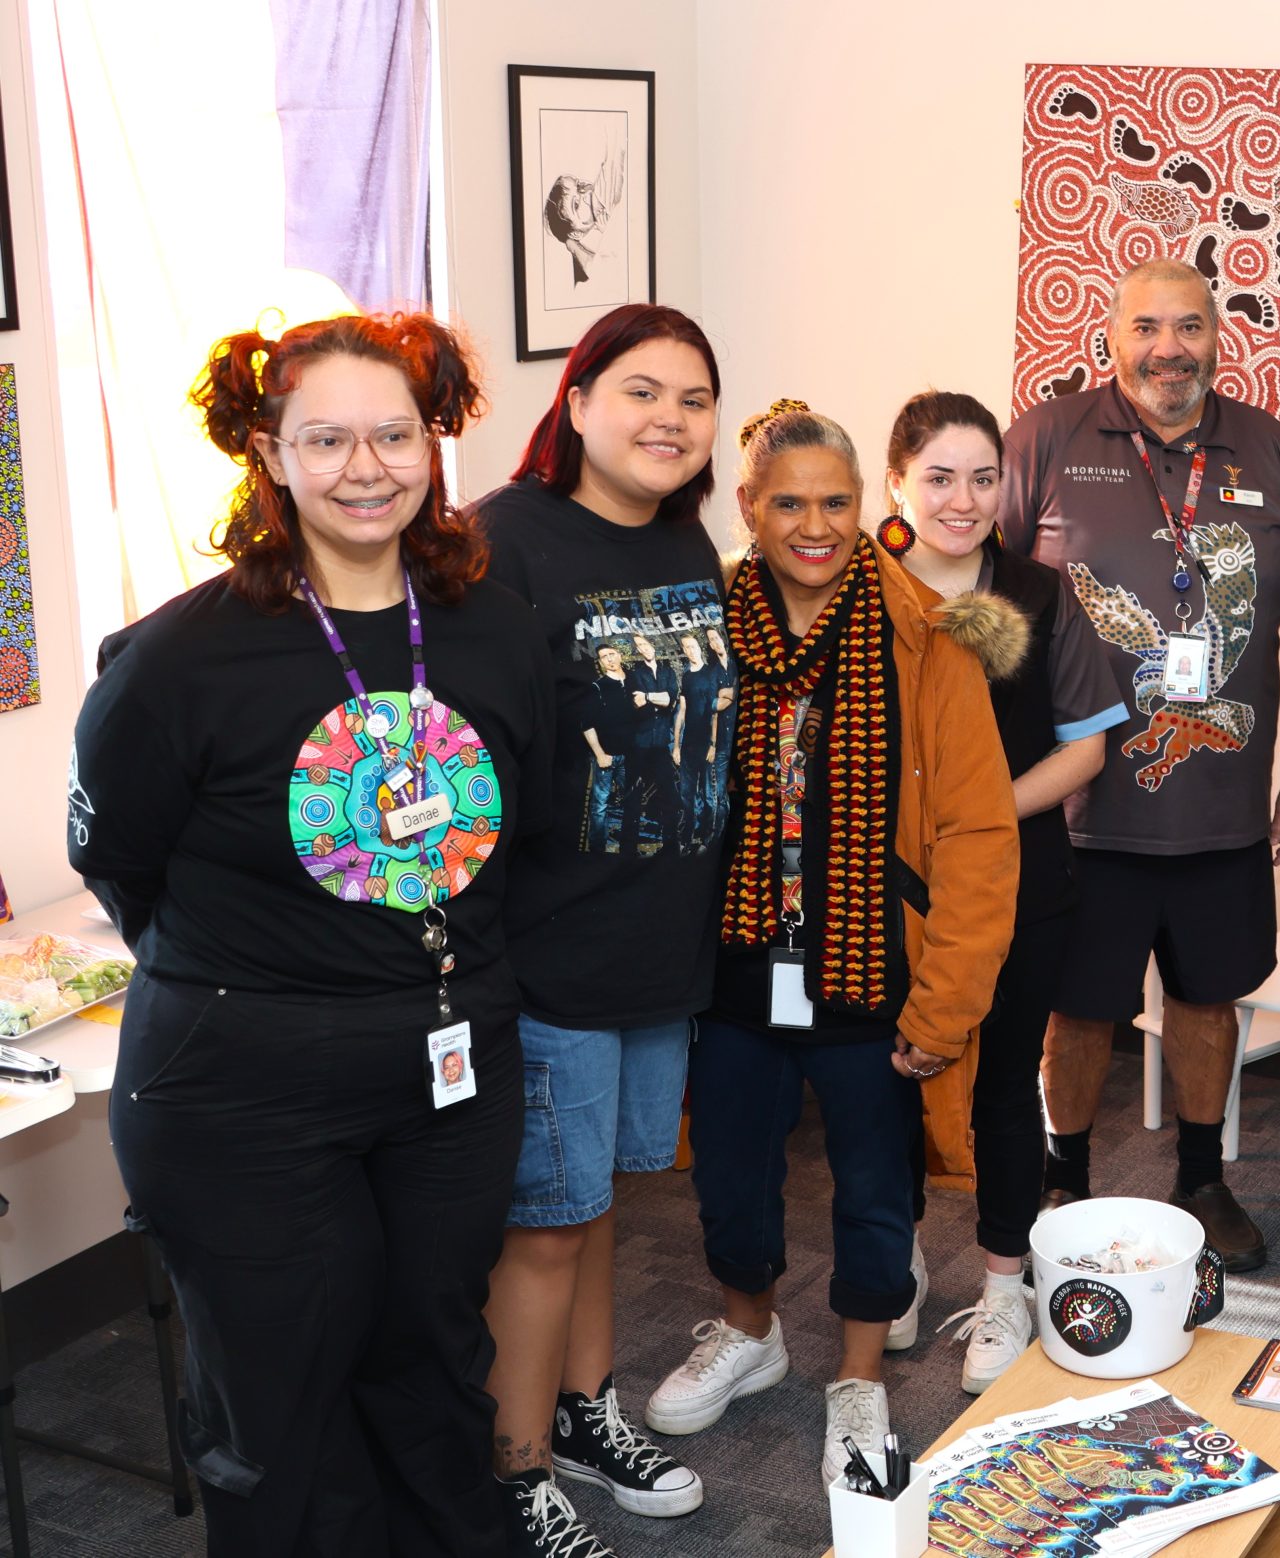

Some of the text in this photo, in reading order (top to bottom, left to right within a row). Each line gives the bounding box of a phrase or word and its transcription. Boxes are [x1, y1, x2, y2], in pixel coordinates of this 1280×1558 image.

[1064, 466, 1132, 478] ABORIGINAL
[574, 604, 724, 640] NICKELBAC
[402, 806, 440, 829] Danae
[1052, 1281, 1128, 1317] CELEBRATING NAIDOC WEEK
